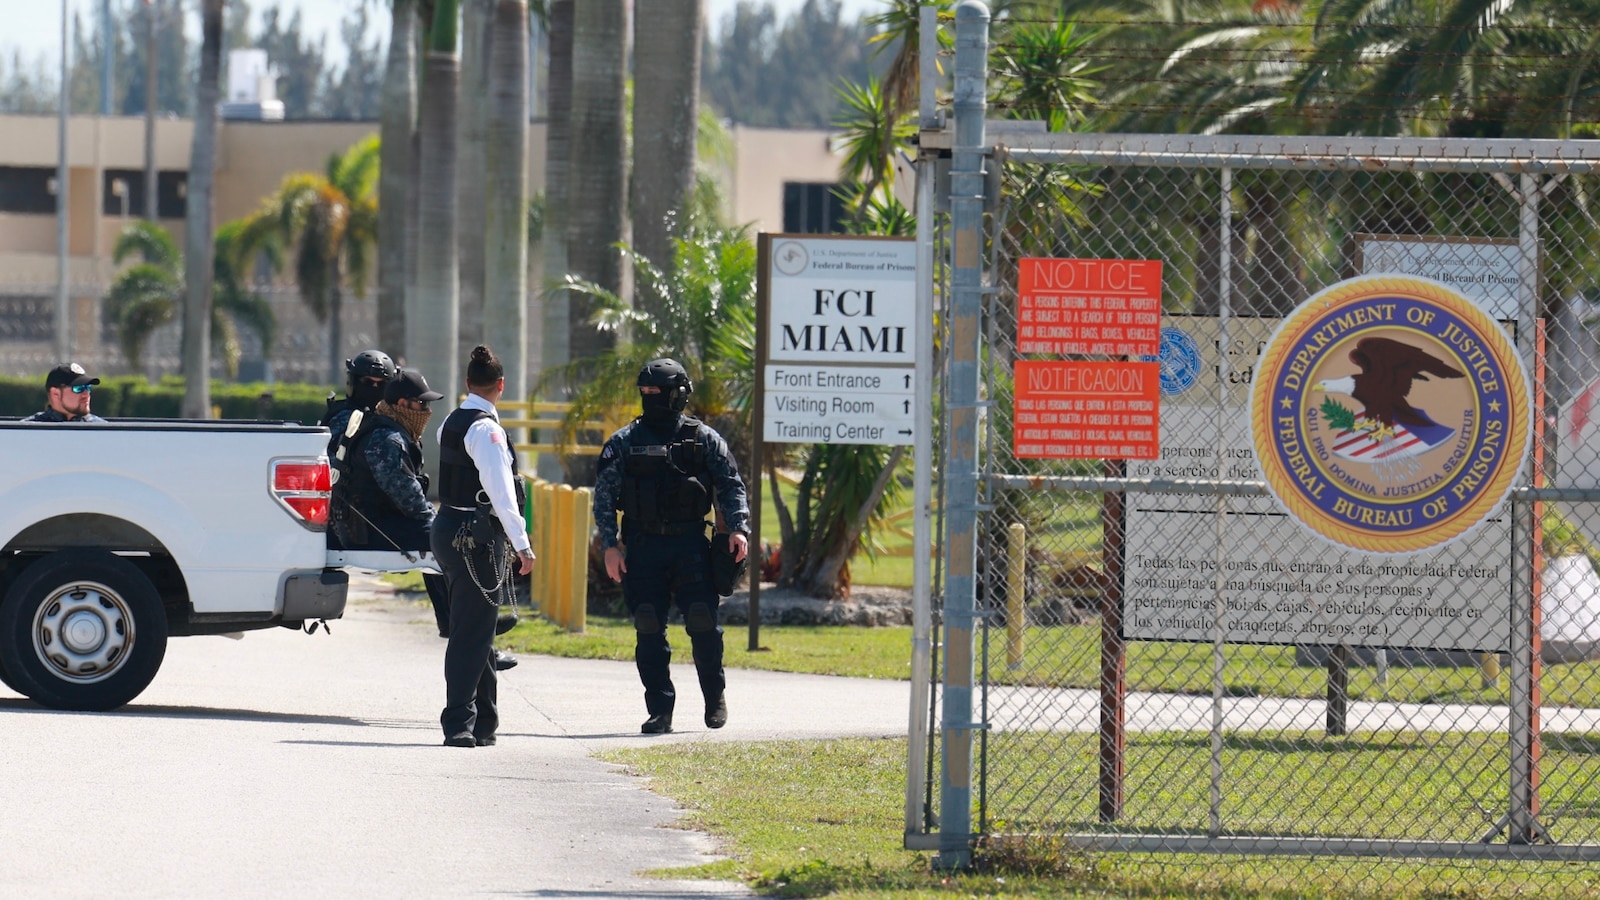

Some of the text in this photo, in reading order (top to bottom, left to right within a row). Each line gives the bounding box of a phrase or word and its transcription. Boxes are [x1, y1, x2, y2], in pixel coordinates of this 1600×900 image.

[876, 251, 897, 259] Justice
[813, 261, 916, 272] Federal Bureau of Prisons
[1034, 261, 1145, 290] NOTICE
[1442, 273, 1474, 283] Bureau
[1476, 273, 1485, 283] of
[1487, 274, 1519, 284] Prisons
[813, 288, 876, 317] FCI
[1022, 297, 1032, 308] ALL
[1062, 297, 1086, 309] ENTERING
[1104, 298, 1126, 309] FEDERAL
[1130, 298, 1157, 310] PROPERTY
[1022, 310, 1033, 322] ARE
[1036, 310, 1059, 322] SUBJECT
[1063, 311, 1071, 323] TO
[1074, 311, 1078, 323] A
[1082, 311, 1103, 323] SEARCH
[1135, 312, 1157, 324] PERSON
[781, 324, 907, 353] MIAMI
[1022, 326, 1034, 338] AND
[1283, 304, 1396, 391] DEPARTMENT
[1407, 307, 1435, 325] OF
[1438, 322, 1499, 393] JUSTICE
[774, 370, 881, 388] Front Entrance
[1028, 367, 1143, 391] NOTIFICACION
[775, 396, 875, 417] Visiting Room
[775, 421, 885, 442] Training Center
[1162, 446, 1211, 459] persons
[1307, 407, 1473, 497] QUI PRO DOMINA JUSTITIA SEQUITUR
[1138, 465, 1150, 475] to
[1154, 467, 1160, 476] a
[1165, 464, 1206, 476] search
[1279, 416, 1502, 526] FEDERAL BUREAU OF PRISONS
[1135, 555, 1499, 579] Todas las peonas que entran a esta propiedad Federal
[1134, 578, 1157, 588] son
[1161, 575, 1205, 592] sujetas
[1210, 582, 1217, 590] a
[1336, 581, 1360, 594] Sus
[1364, 584, 1422, 598] personas
[1427, 587, 1434, 600] y
[1135, 596, 1217, 611] pertenencias
[1390, 602, 1462, 619] recipientes
[1467, 608, 1482, 618] en
[1134, 614, 1152, 627] los
